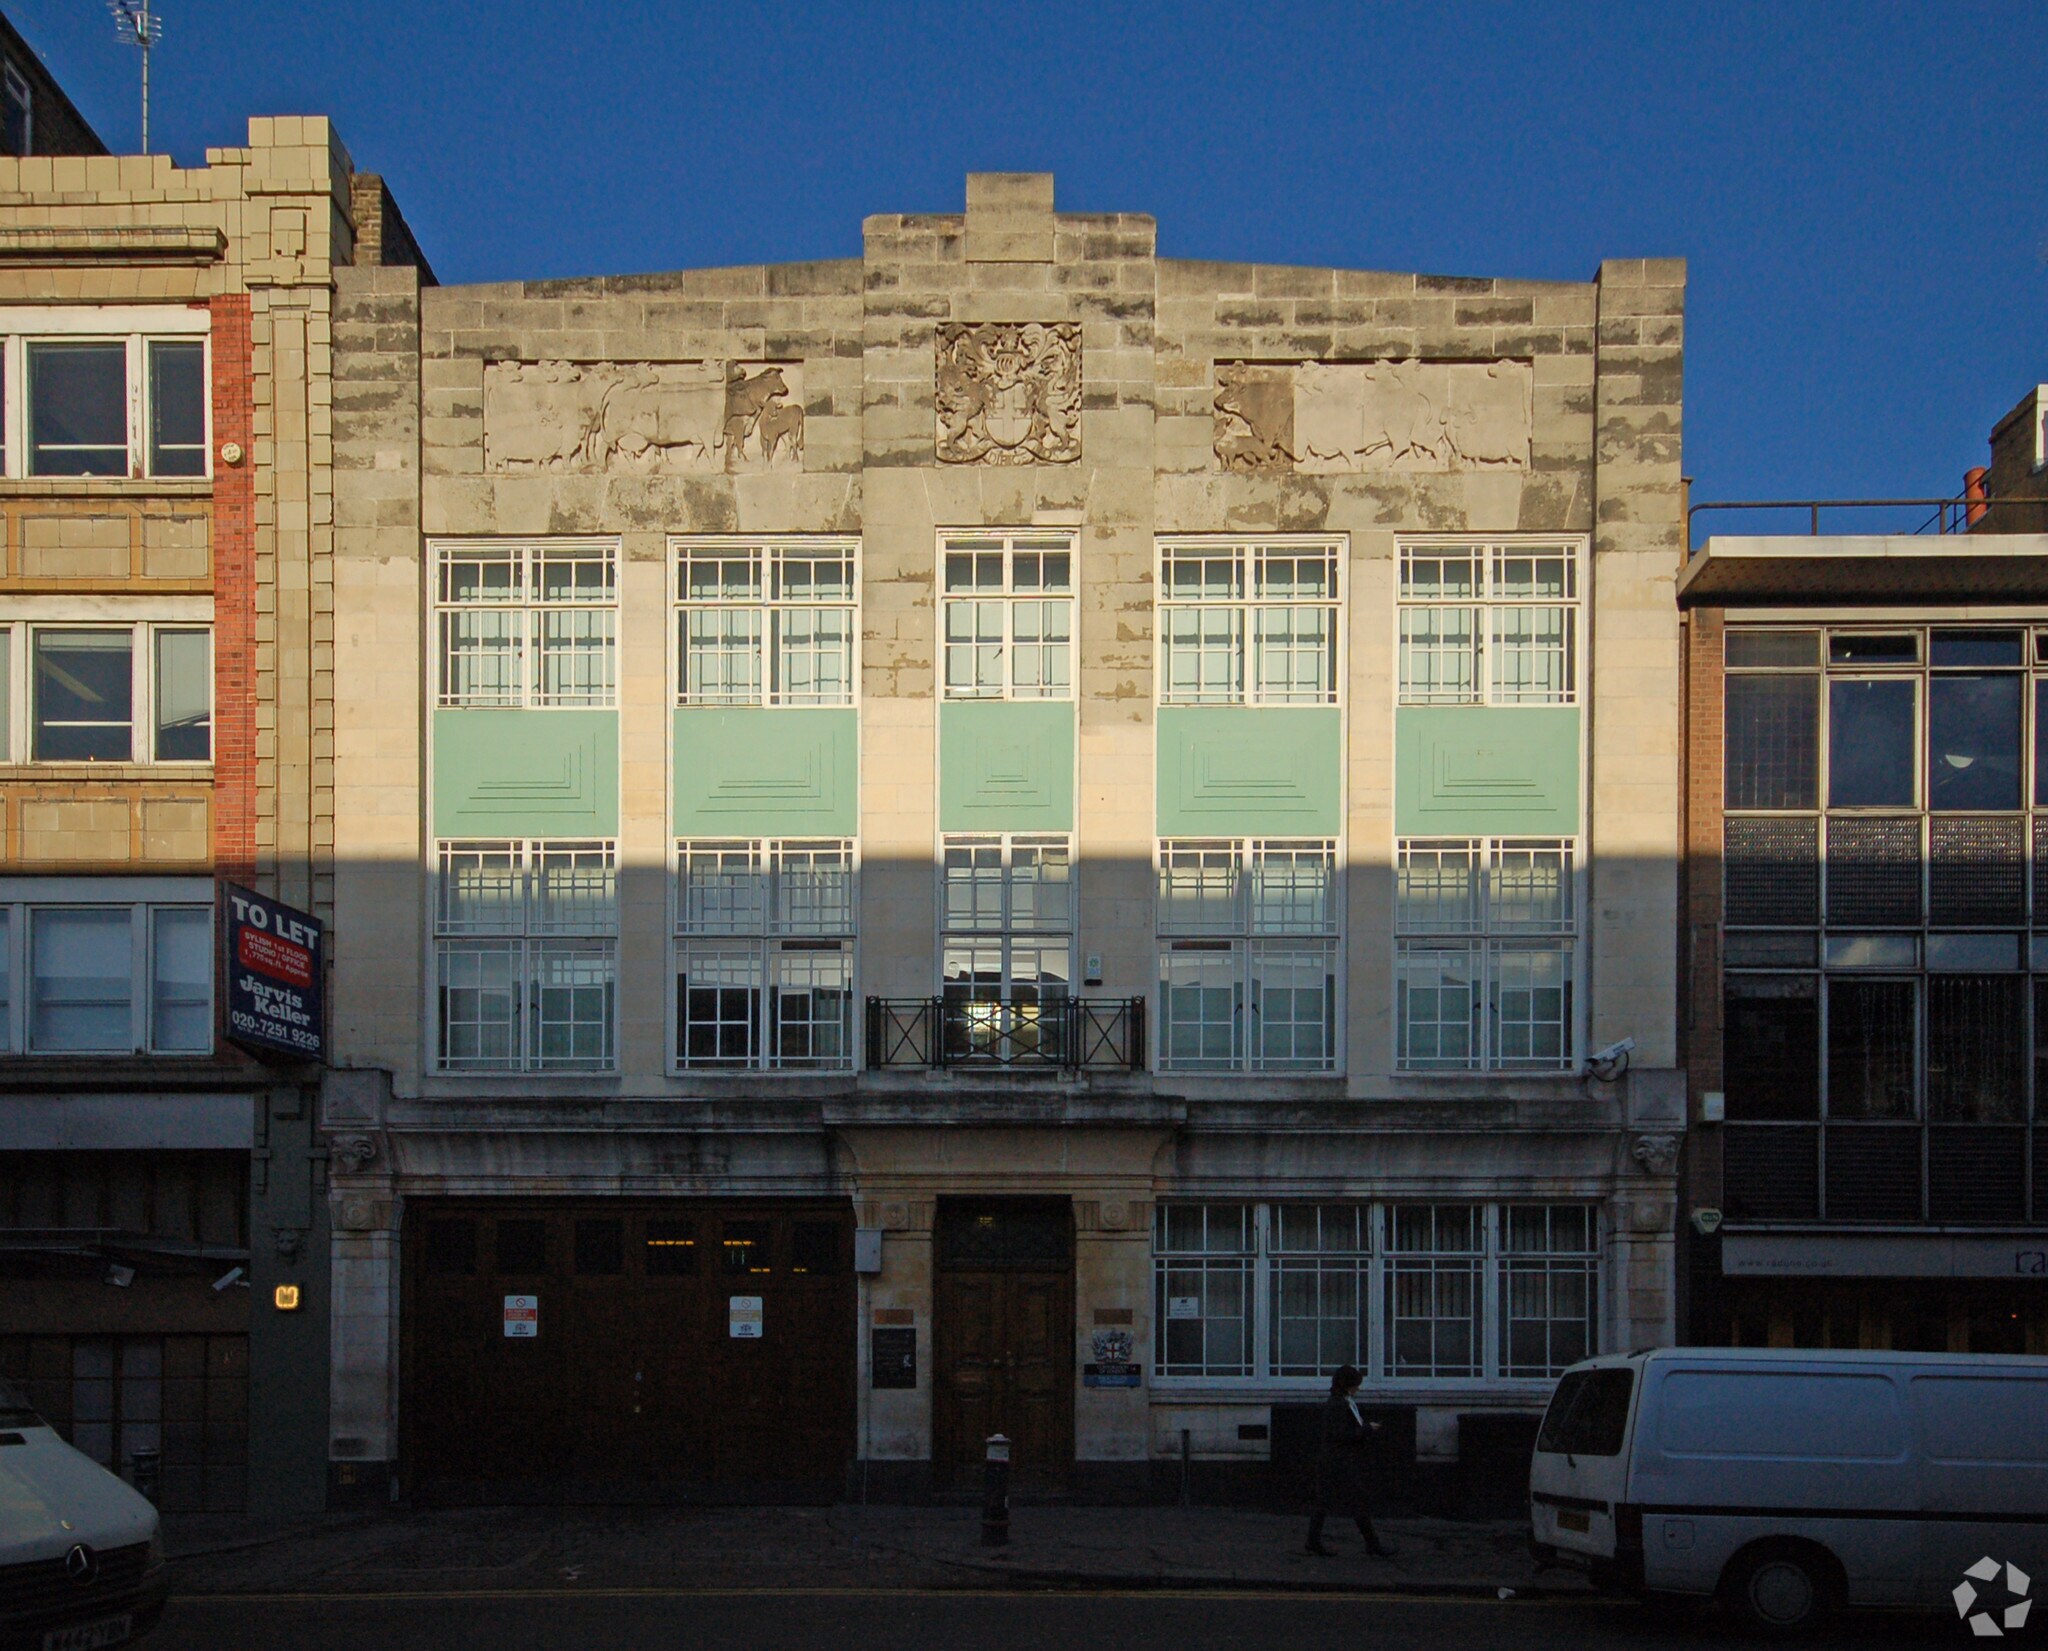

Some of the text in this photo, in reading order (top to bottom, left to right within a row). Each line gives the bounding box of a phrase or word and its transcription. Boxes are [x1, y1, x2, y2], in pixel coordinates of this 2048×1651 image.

[231, 896, 318, 950] TO LET
[248, 941, 276, 958] STUDIO
[281, 954, 305, 970] OFFICE
[273, 943, 285, 953] 1st
[286, 947, 309, 963] FLOOR
[239, 974, 303, 1008] Jarvis
[254, 996, 311, 1027] Keller
[231, 1010, 288, 1039] 020-7251
[291, 1028, 320, 1048] 9226
